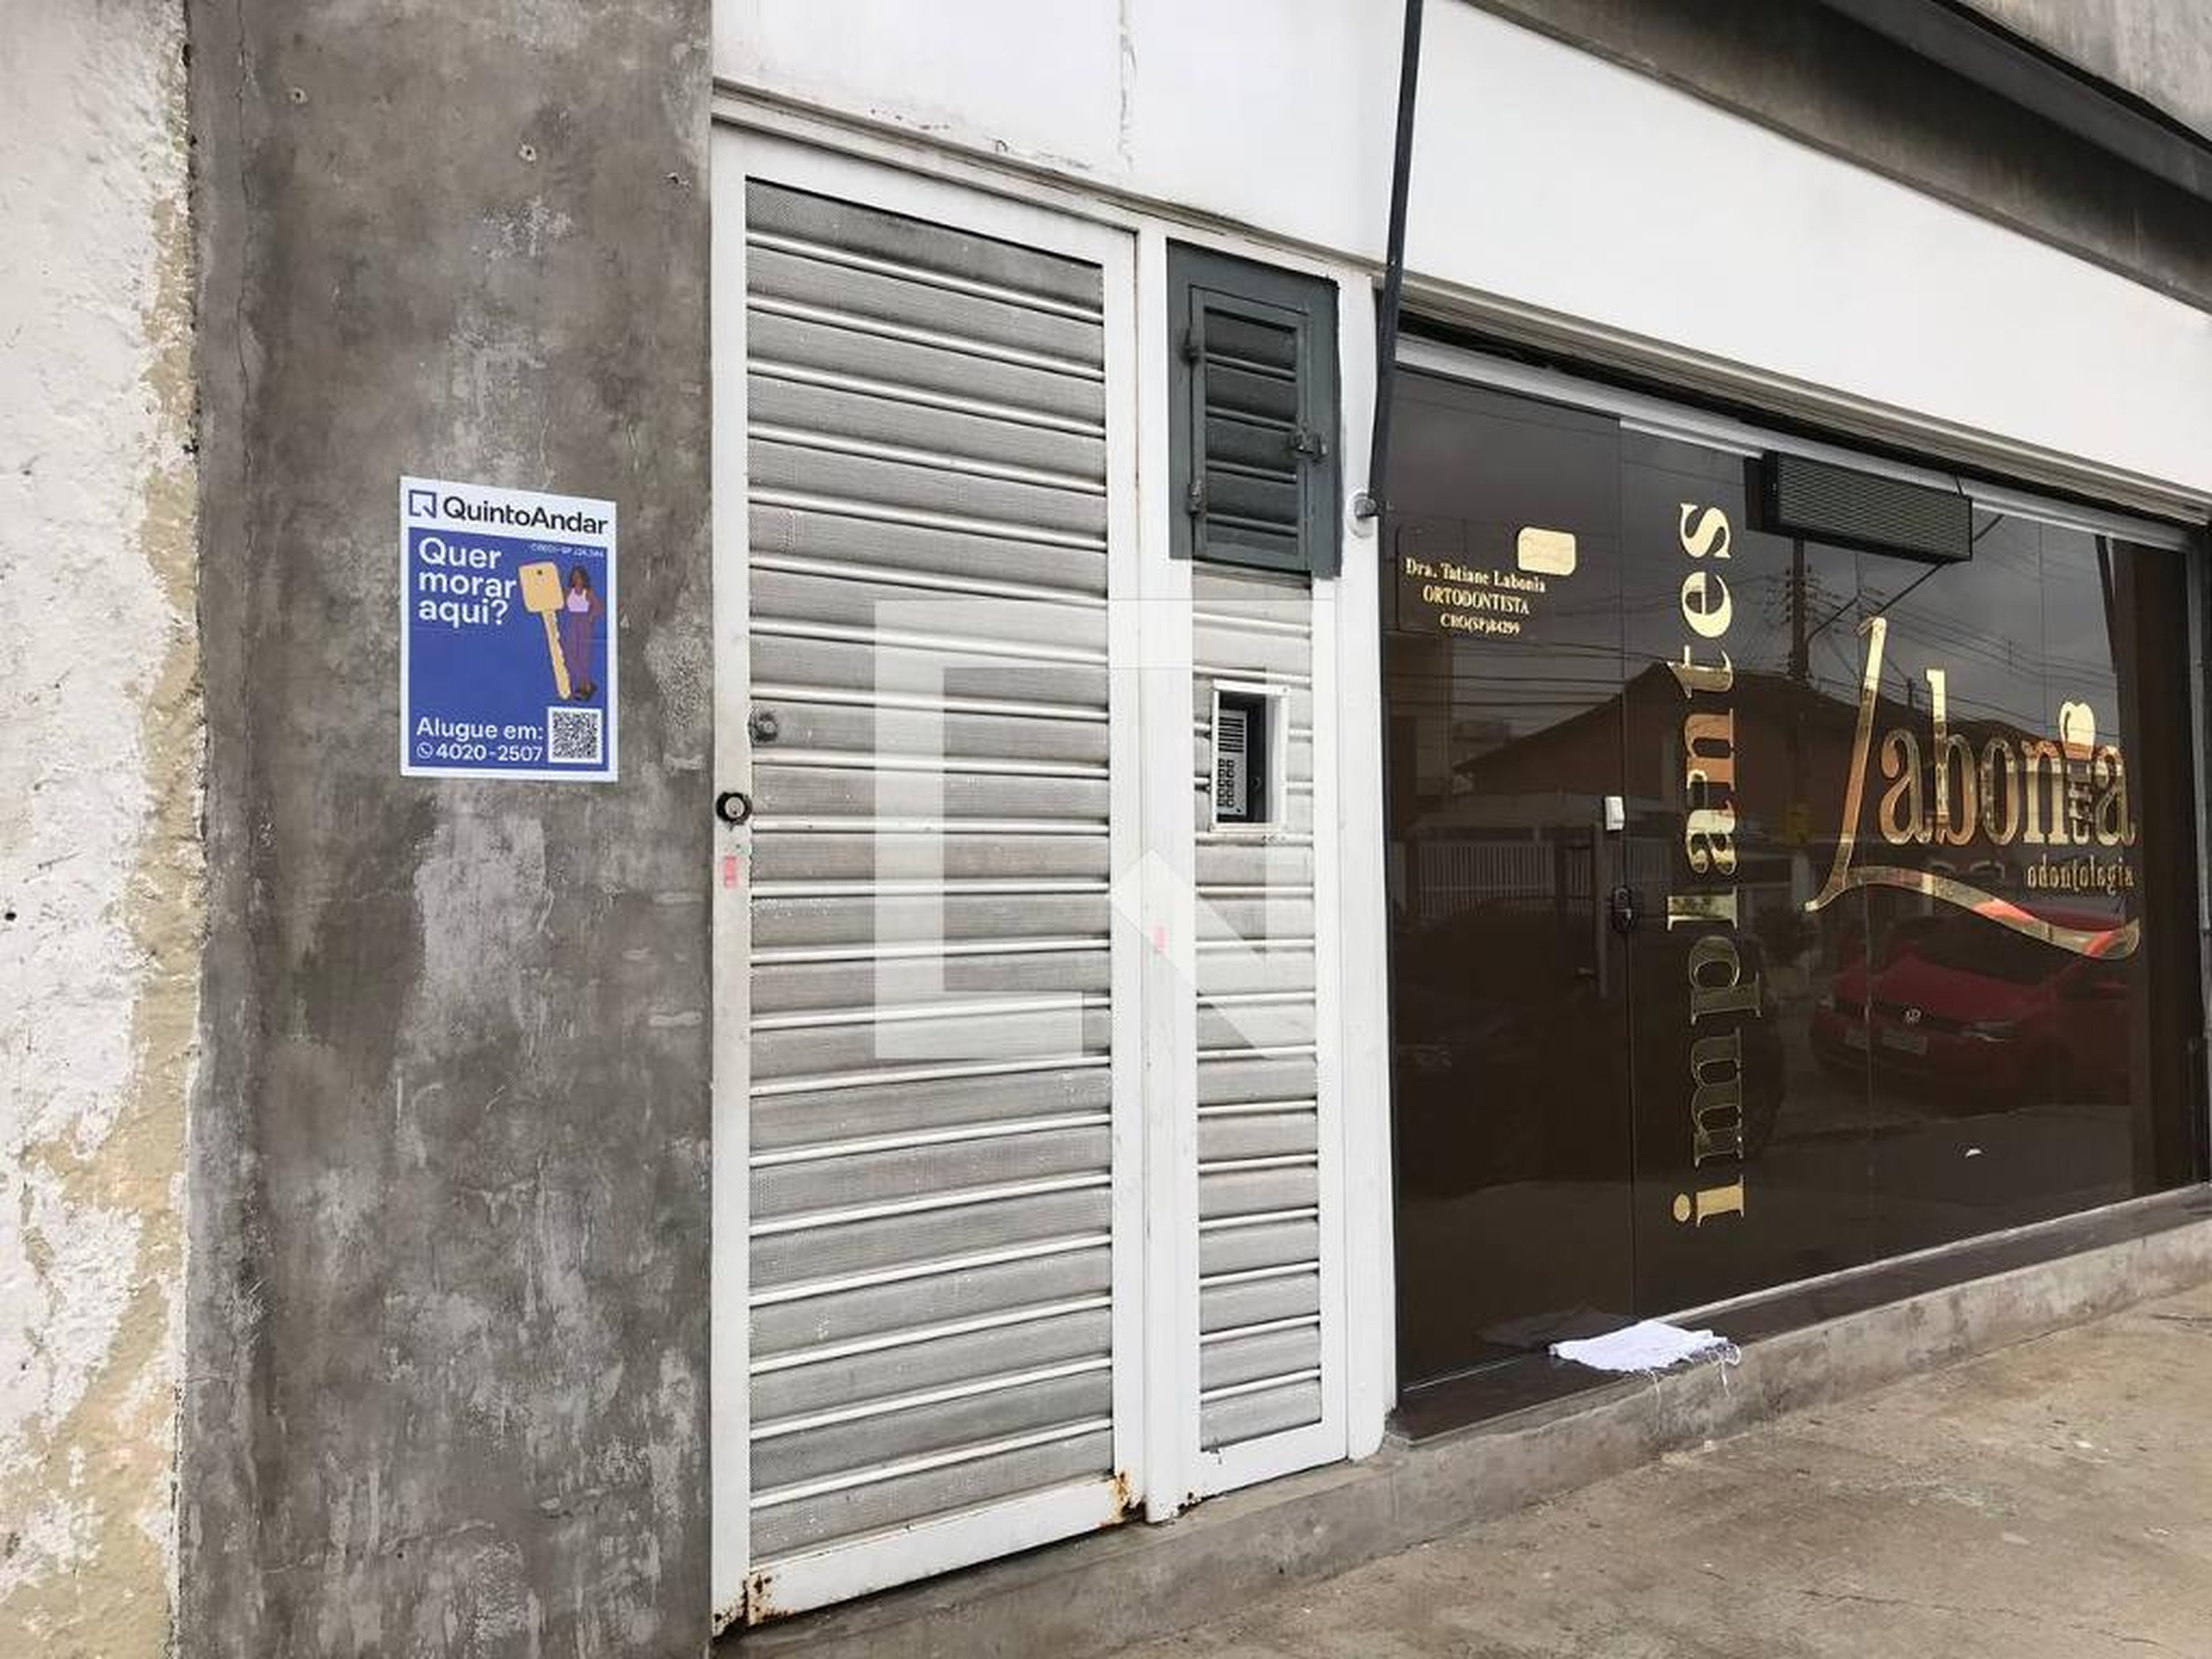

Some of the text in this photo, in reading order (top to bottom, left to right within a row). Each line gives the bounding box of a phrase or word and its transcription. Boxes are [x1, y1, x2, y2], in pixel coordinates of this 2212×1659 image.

[443, 496, 609, 535] QuintoAndar
[418, 537, 501, 569] Quer
[418, 571, 517, 599] morar
[1406, 557, 1438, 578] Dra.
[1440, 562, 1490, 585] Tatiane
[418, 599, 509, 628] aqui?
[1423, 584, 1529, 615] ORTODONTISTA
[416, 717, 544, 742] Alugue em:
[436, 743, 543, 762] 4020-2507
[1666, 502, 1764, 1227] implantes
[2027, 853, 2135, 896] odontologia
